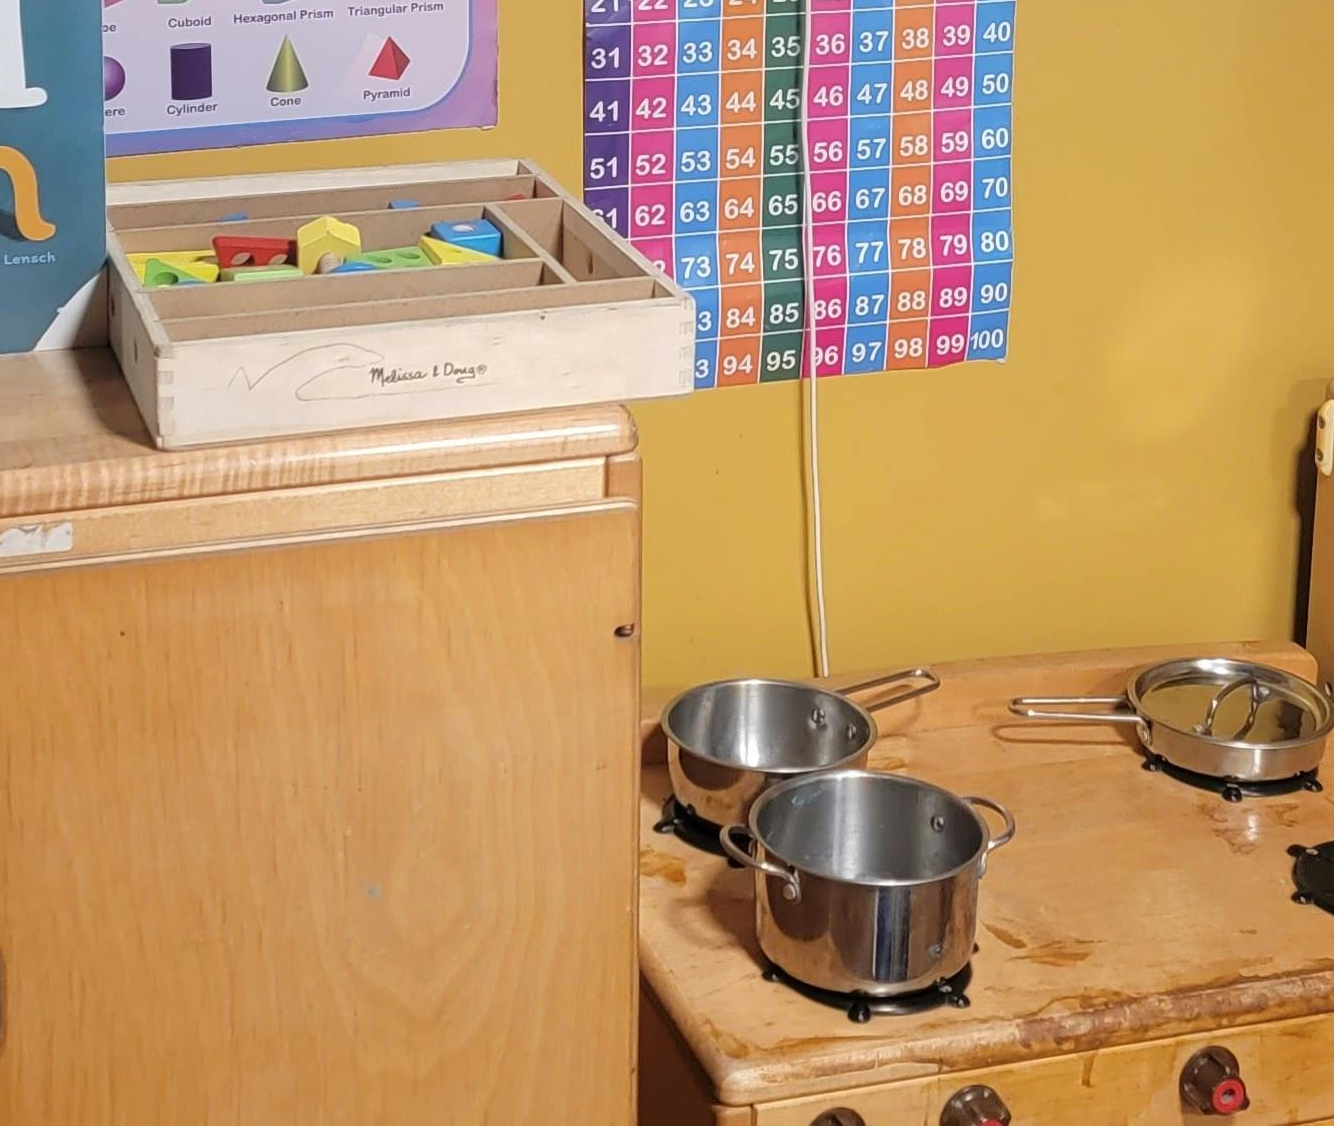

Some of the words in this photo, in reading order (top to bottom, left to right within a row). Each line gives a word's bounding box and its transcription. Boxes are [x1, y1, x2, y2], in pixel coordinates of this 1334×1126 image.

[233, 10, 297, 27] Hexagonal
[300, 7, 334, 20] Prism
[347, 3, 408, 19] Triangular
[410, 1, 444, 14] Prism
[168, 15, 212, 29] Cuboid
[270, 95, 301, 107] Cone
[363, 87, 411, 102] Pyramid
[167, 101, 218, 117] Cylinder
[3, 251, 56, 266] Lensch
[851, 341, 882, 362] 97
[893, 337, 923, 358] 98
[935, 333, 966, 354] 99
[971, 328, 1004, 349] 100
[369, 367, 427, 387] Melissa
